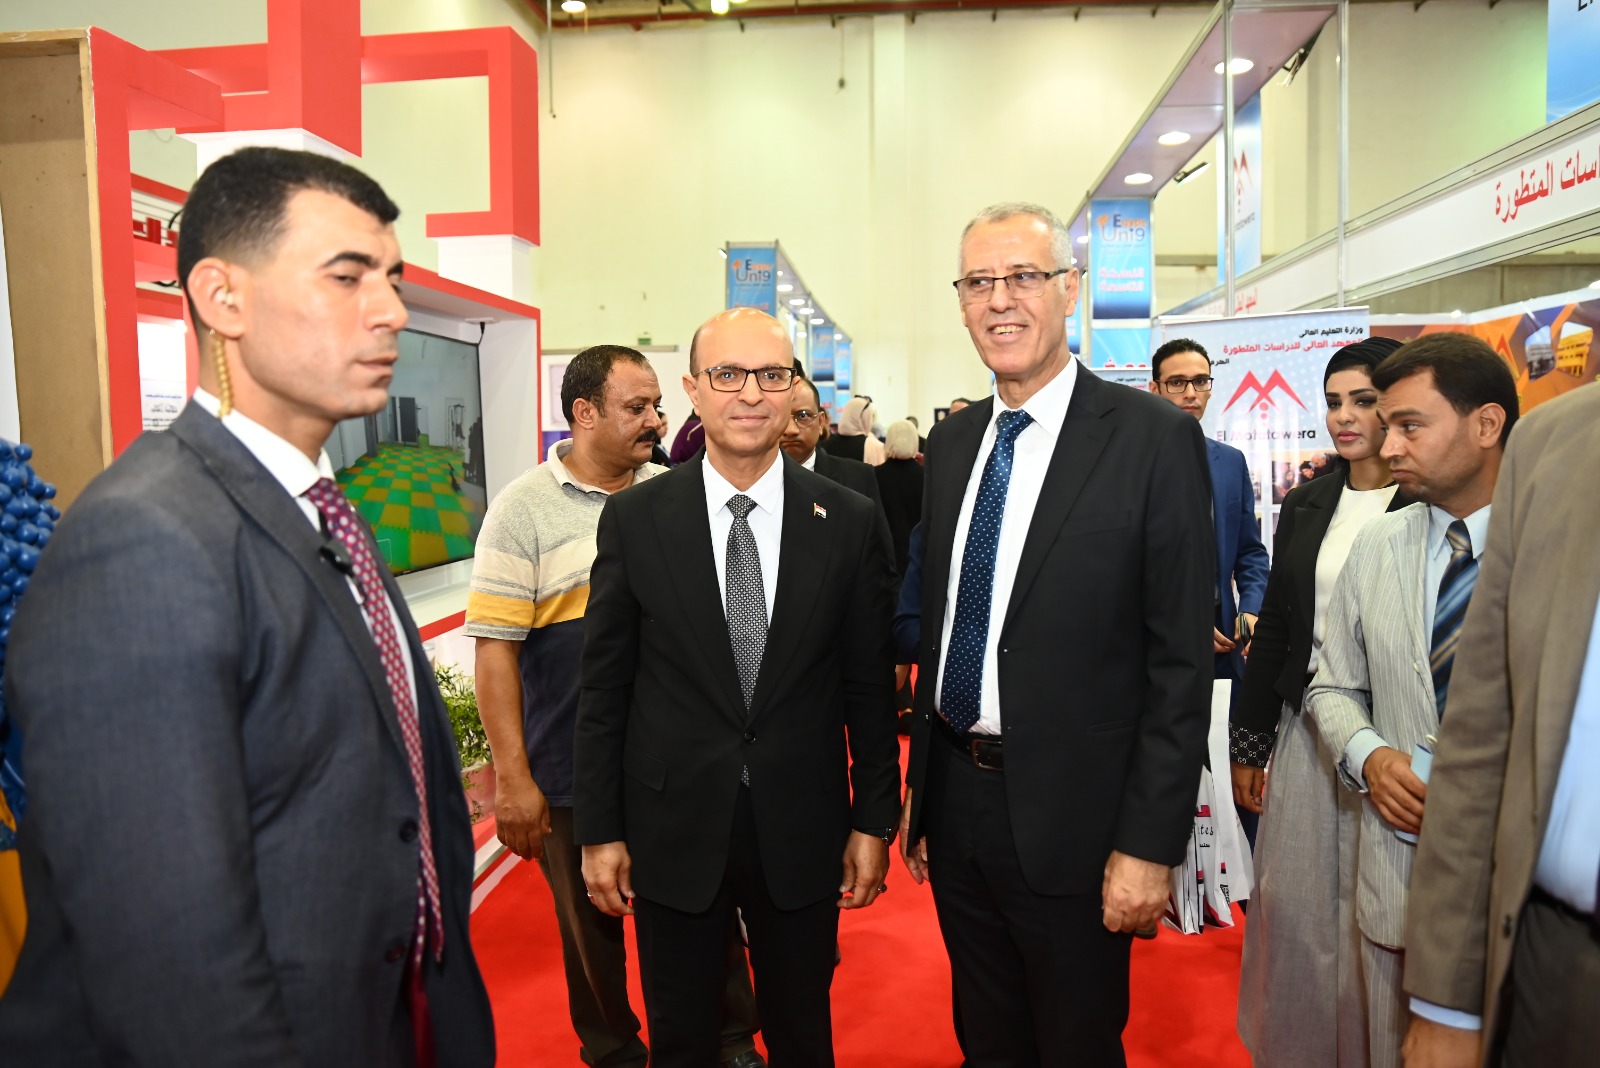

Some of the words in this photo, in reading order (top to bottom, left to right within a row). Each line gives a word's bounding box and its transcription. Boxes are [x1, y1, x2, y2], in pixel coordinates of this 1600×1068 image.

[1495, 160, 1554, 223] المتطورة
[1320, 327, 1343, 337] التعليم
[1344, 326, 1363, 335] وزارة
[1223, 344, 1261, 355] المتطورة
[1263, 342, 1301, 352] للدراسات
